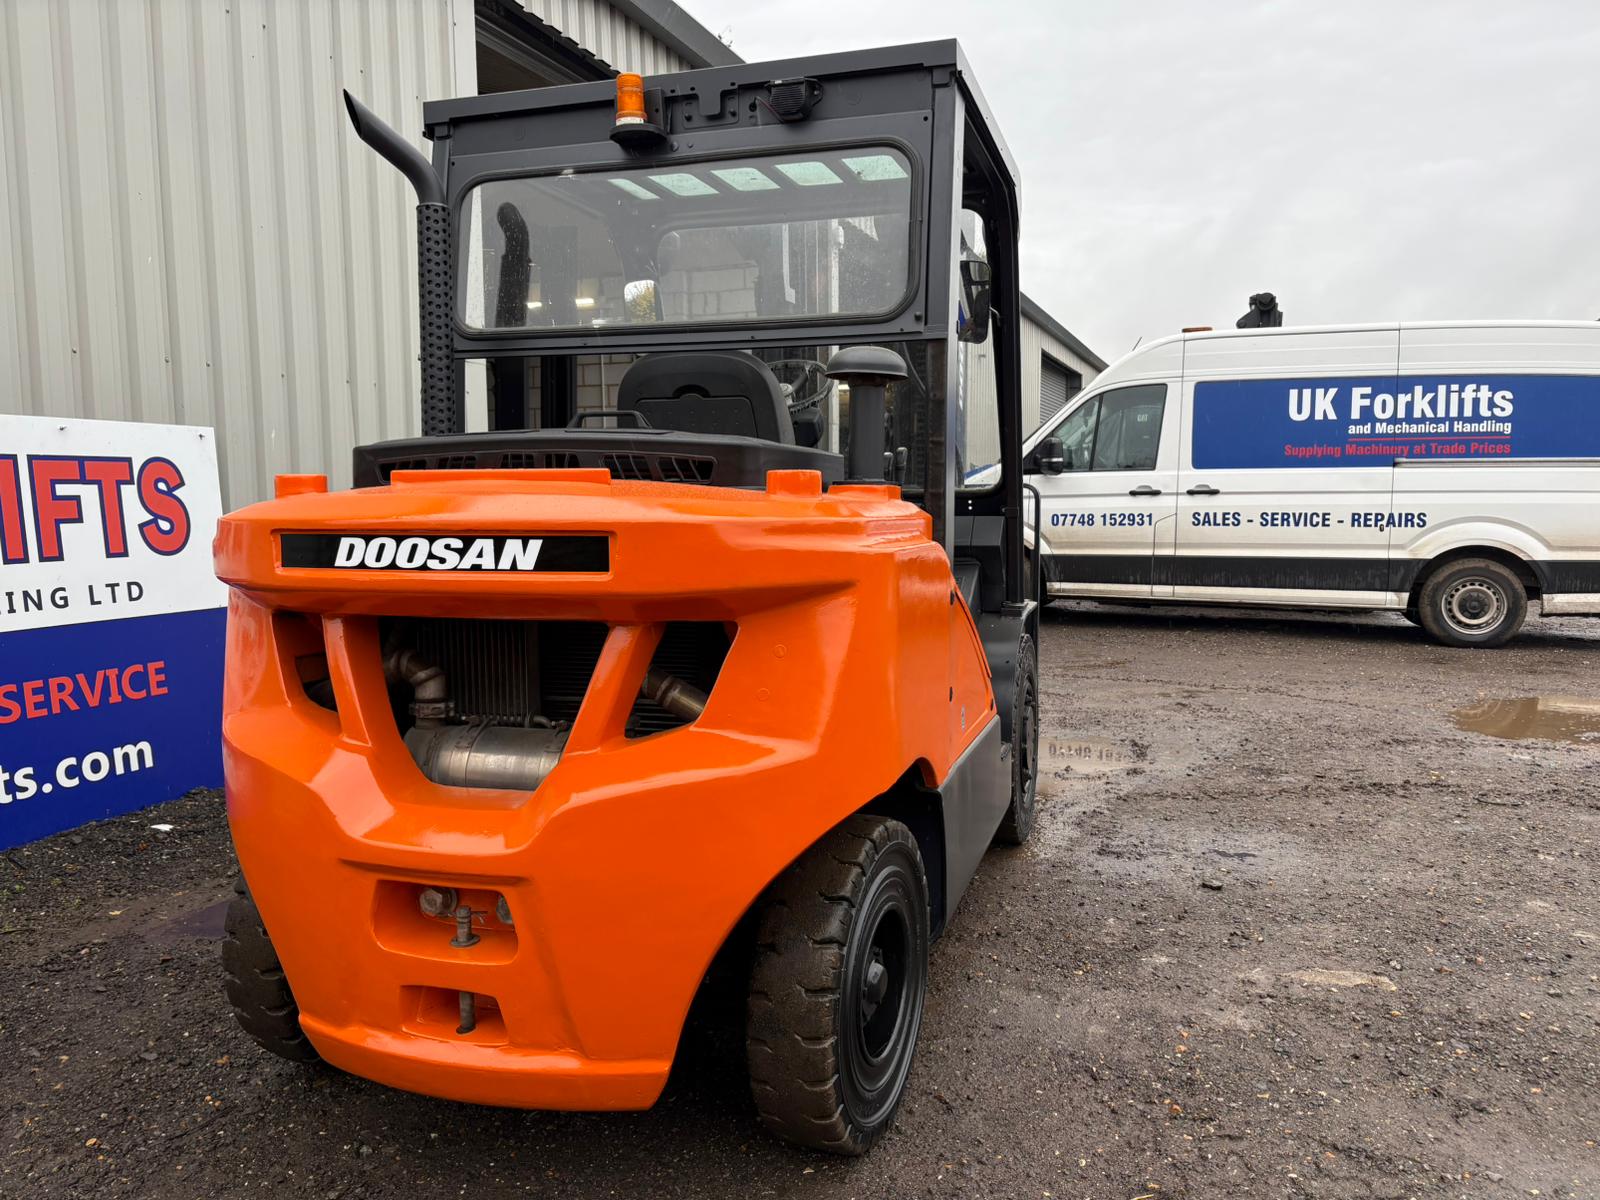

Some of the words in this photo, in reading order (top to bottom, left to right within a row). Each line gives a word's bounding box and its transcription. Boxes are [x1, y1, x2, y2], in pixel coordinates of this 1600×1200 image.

[1288, 387, 1338, 421] UK
[1350, 384, 1514, 420] Forklifts
[1348, 422, 1371, 434] and
[1375, 421, 1449, 434] Mechanical
[1453, 420, 1512, 434] Handling
[1284, 444, 1341, 458] Supplying
[1345, 443, 1409, 457] Machinery
[1413, 444, 1426, 455] at
[1430, 443, 1466, 455] Trade
[1470, 442, 1511, 454] Prices
[0, 454, 191, 565] IFTS
[1051, 513, 1095, 527] 07748
[1100, 513, 1153, 527] 152931
[1192, 512, 1241, 527] SALES
[1259, 512, 1331, 528] SERVICE
[1351, 512, 1428, 528] REPAIRS
[334, 537, 543, 570] DOOSAN
[0, 587, 69, 615] ING
[88, 581, 144, 606] LTD
[0, 660, 169, 725] SERVICE
